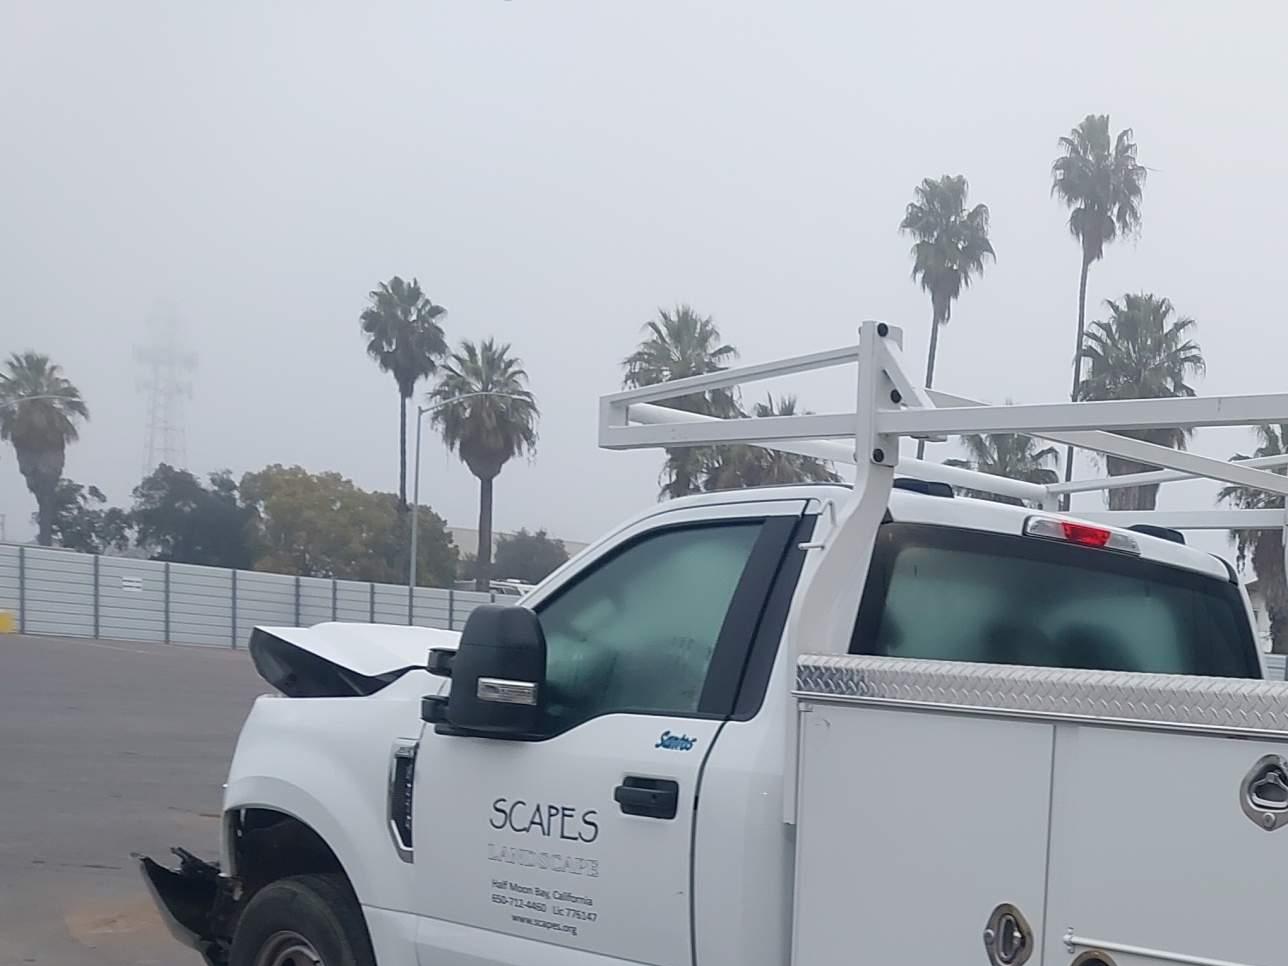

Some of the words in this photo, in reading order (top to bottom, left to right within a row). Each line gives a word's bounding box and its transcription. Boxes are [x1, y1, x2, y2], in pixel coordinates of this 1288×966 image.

[489, 798, 599, 843] SCAPES
[491, 879, 508, 890] Half
[508, 882, 534, 894] Moon
[552, 890, 593, 907] California
[511, 915, 577, 936] www.scapes.org
